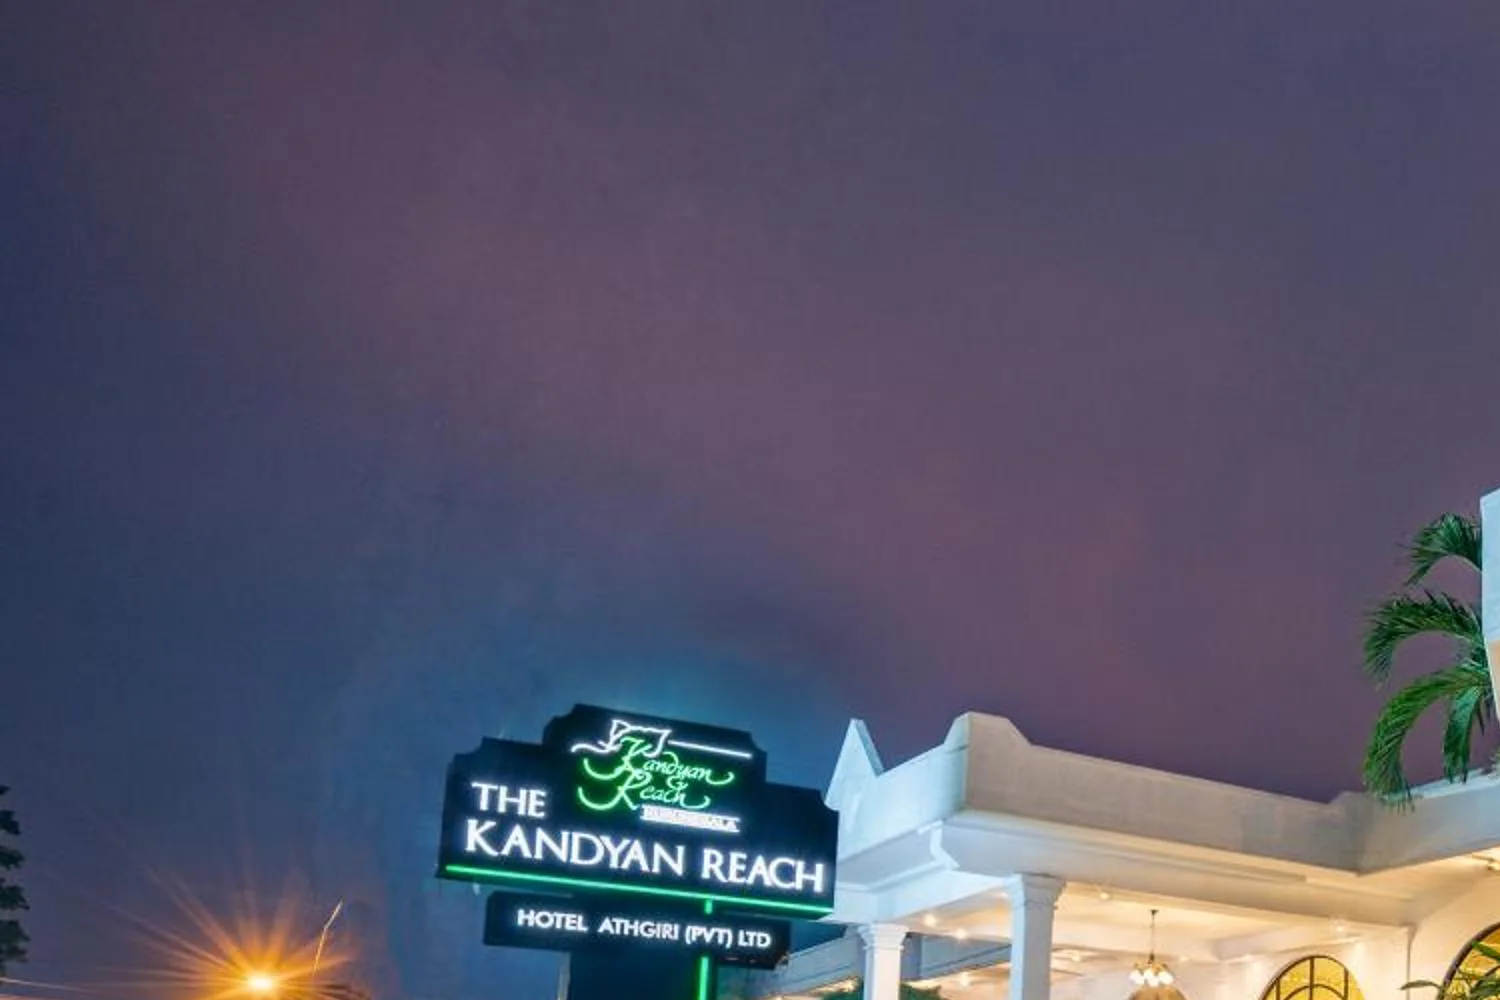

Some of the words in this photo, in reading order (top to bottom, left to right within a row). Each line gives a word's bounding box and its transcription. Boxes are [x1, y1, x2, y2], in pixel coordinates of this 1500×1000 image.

[584, 736, 735, 786] Kandyan
[471, 782, 547, 818] THE
[577, 769, 711, 811] Reach
[465, 818, 686, 877] KANDYAN
[702, 847, 824, 893] REACH
[516, 909, 588, 933] HOTEL
[598, 917, 679, 941] ATHGIRI
[685, 926, 733, 949] (PVT)
[737, 930, 771, 949] LTD
